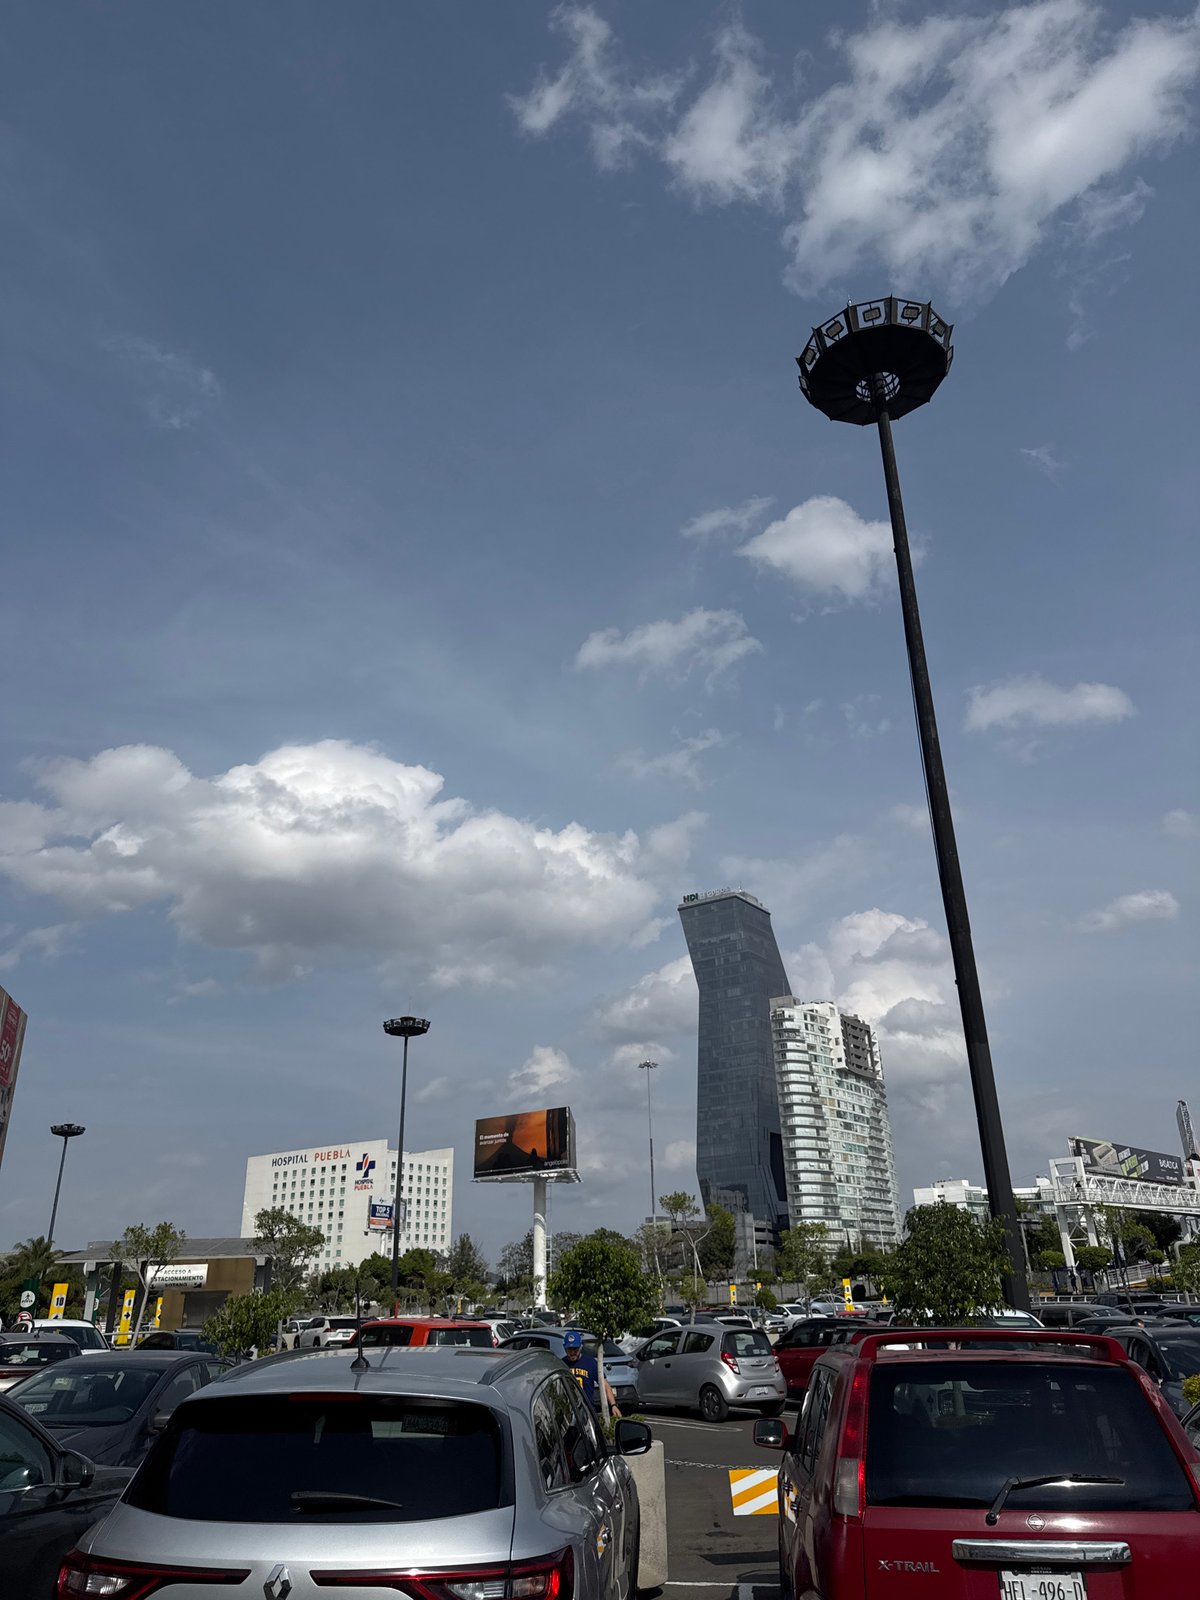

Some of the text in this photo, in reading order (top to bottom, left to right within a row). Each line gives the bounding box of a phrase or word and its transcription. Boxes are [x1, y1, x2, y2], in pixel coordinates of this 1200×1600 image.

[683, 893, 698, 903] HDI
[272, 1149, 351, 1167] HOSPITAL PUEBLA
[376, 1206, 386, 1214] TOP
[55, 1296, 65, 1307] 10
[575, 1368, 589, 1379] STATE
[878, 1559, 940, 1573] X-TRAIL
